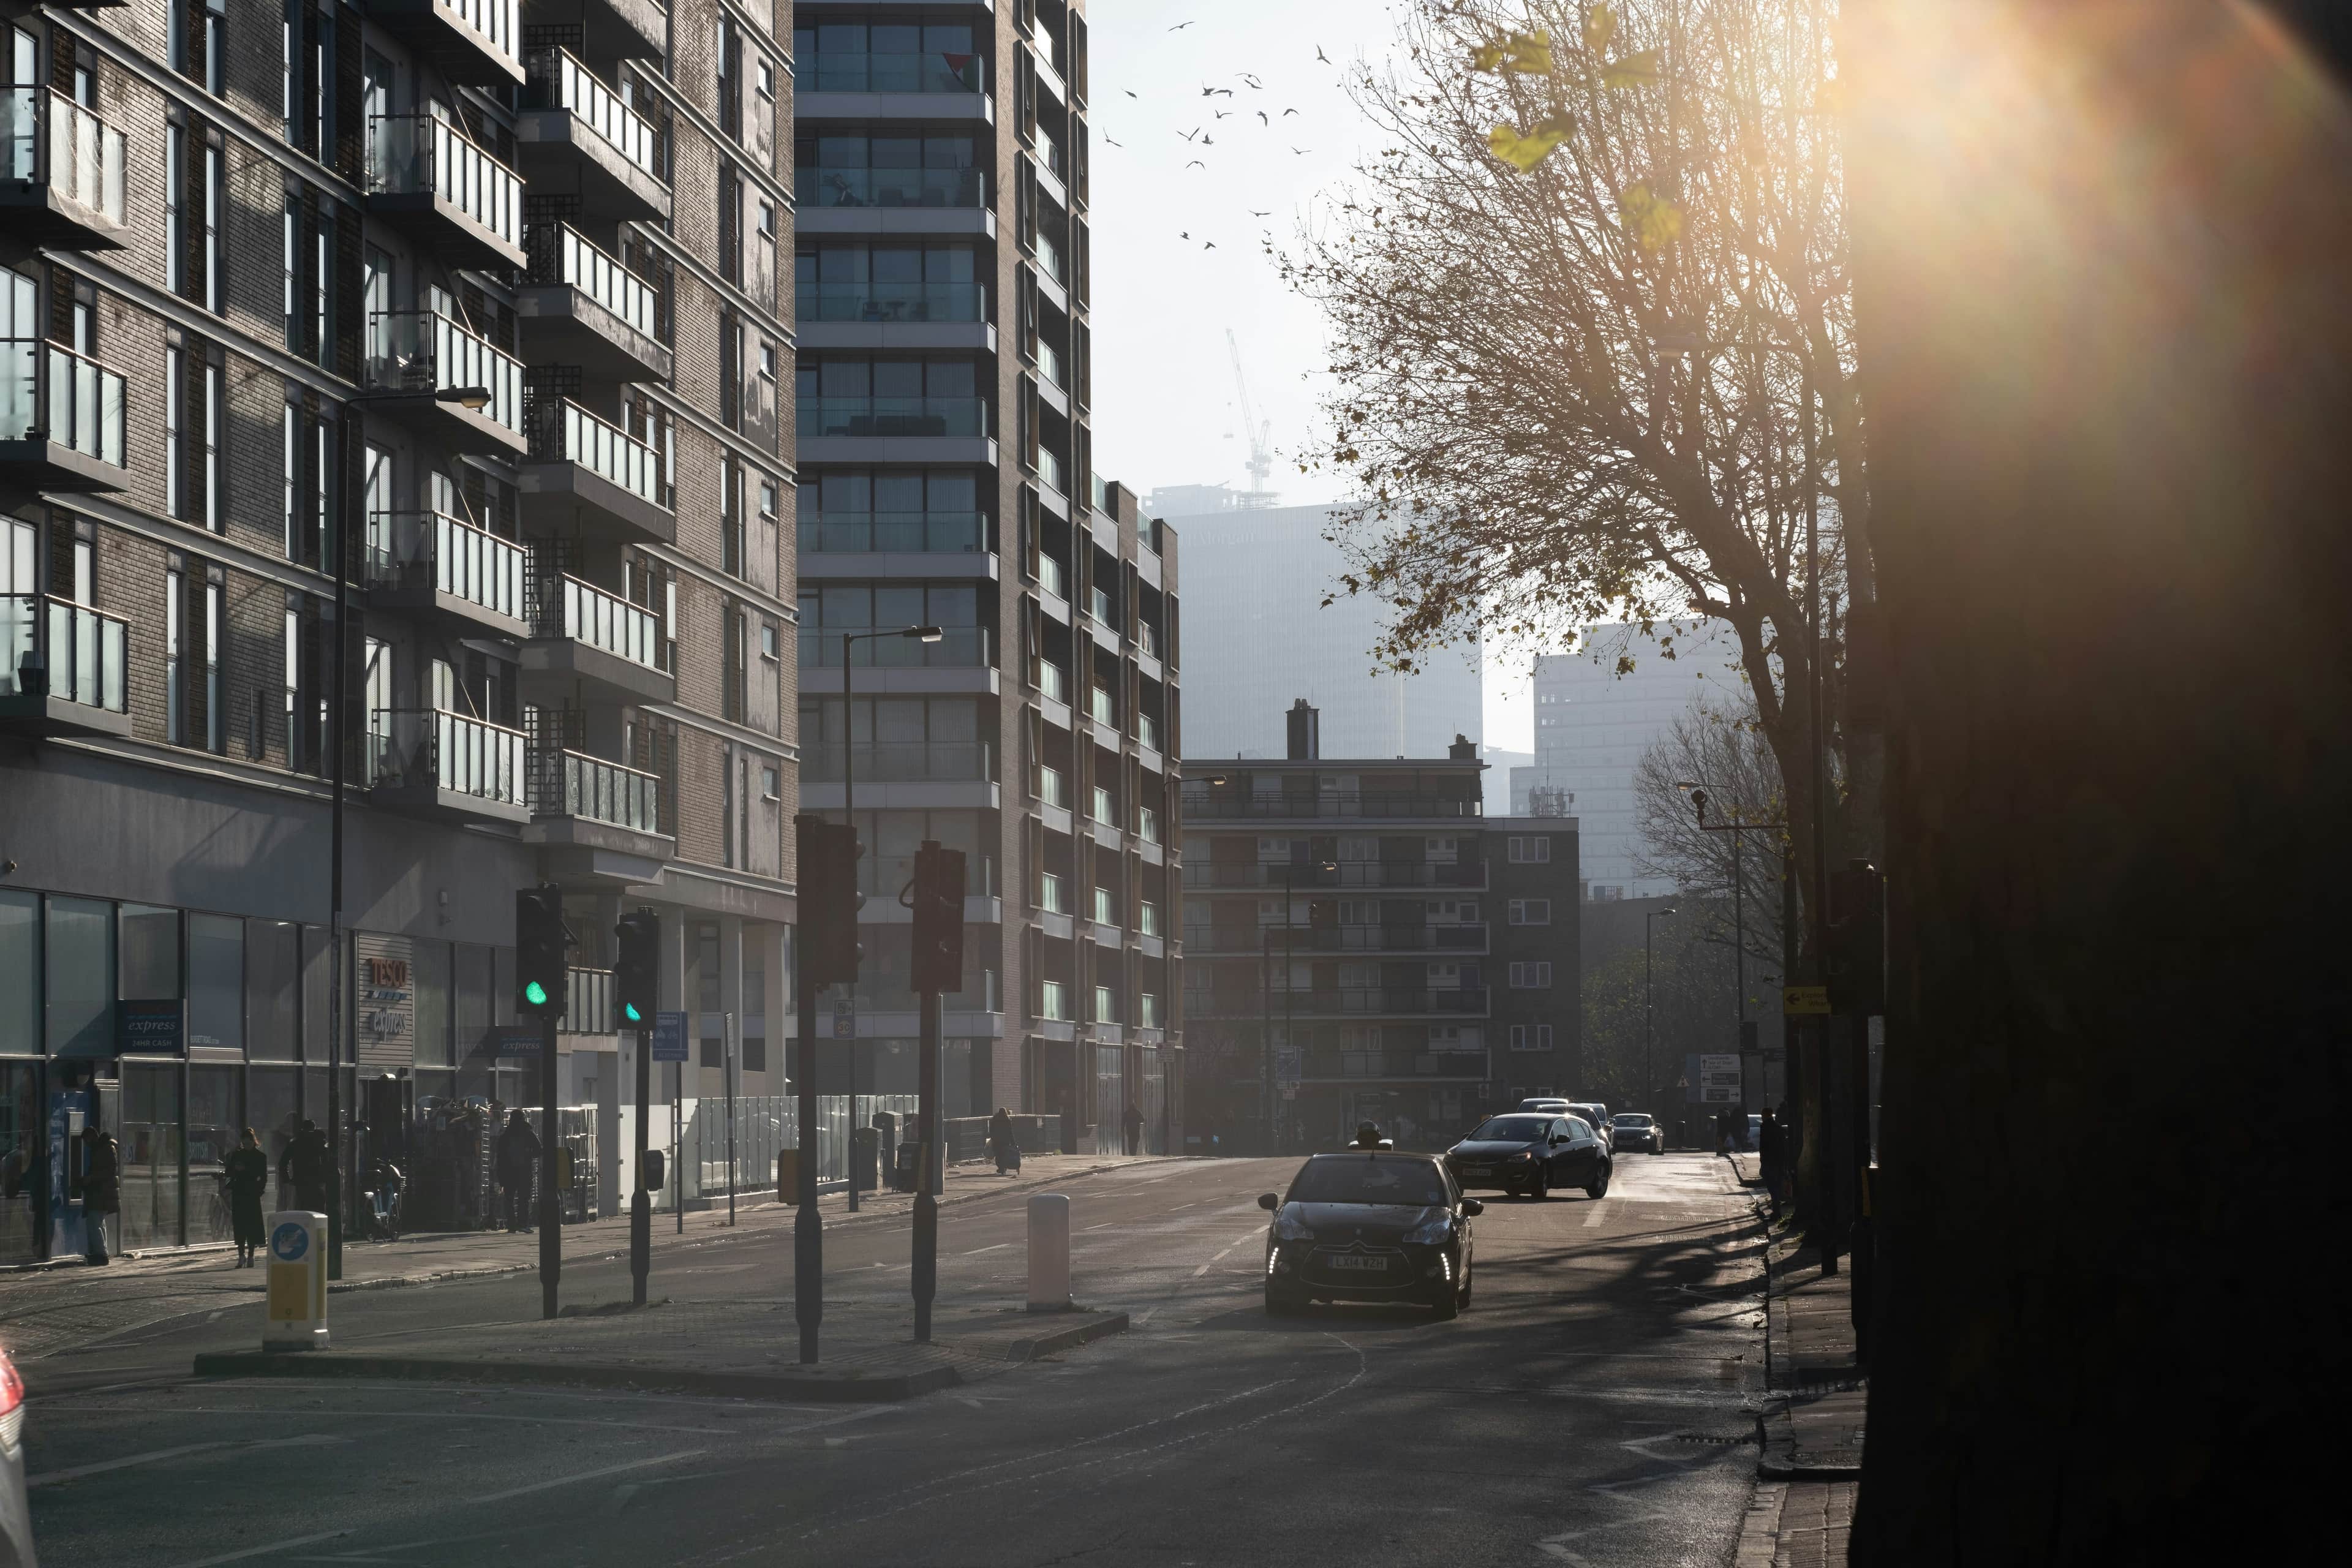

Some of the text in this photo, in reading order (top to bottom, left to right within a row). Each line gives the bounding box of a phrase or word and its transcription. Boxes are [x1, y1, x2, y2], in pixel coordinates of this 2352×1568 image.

[372, 959, 407, 987] TESCO
[128, 1020, 176, 1034] express
[374, 1008, 405, 1044] express
[502, 1042, 539, 1054] express
